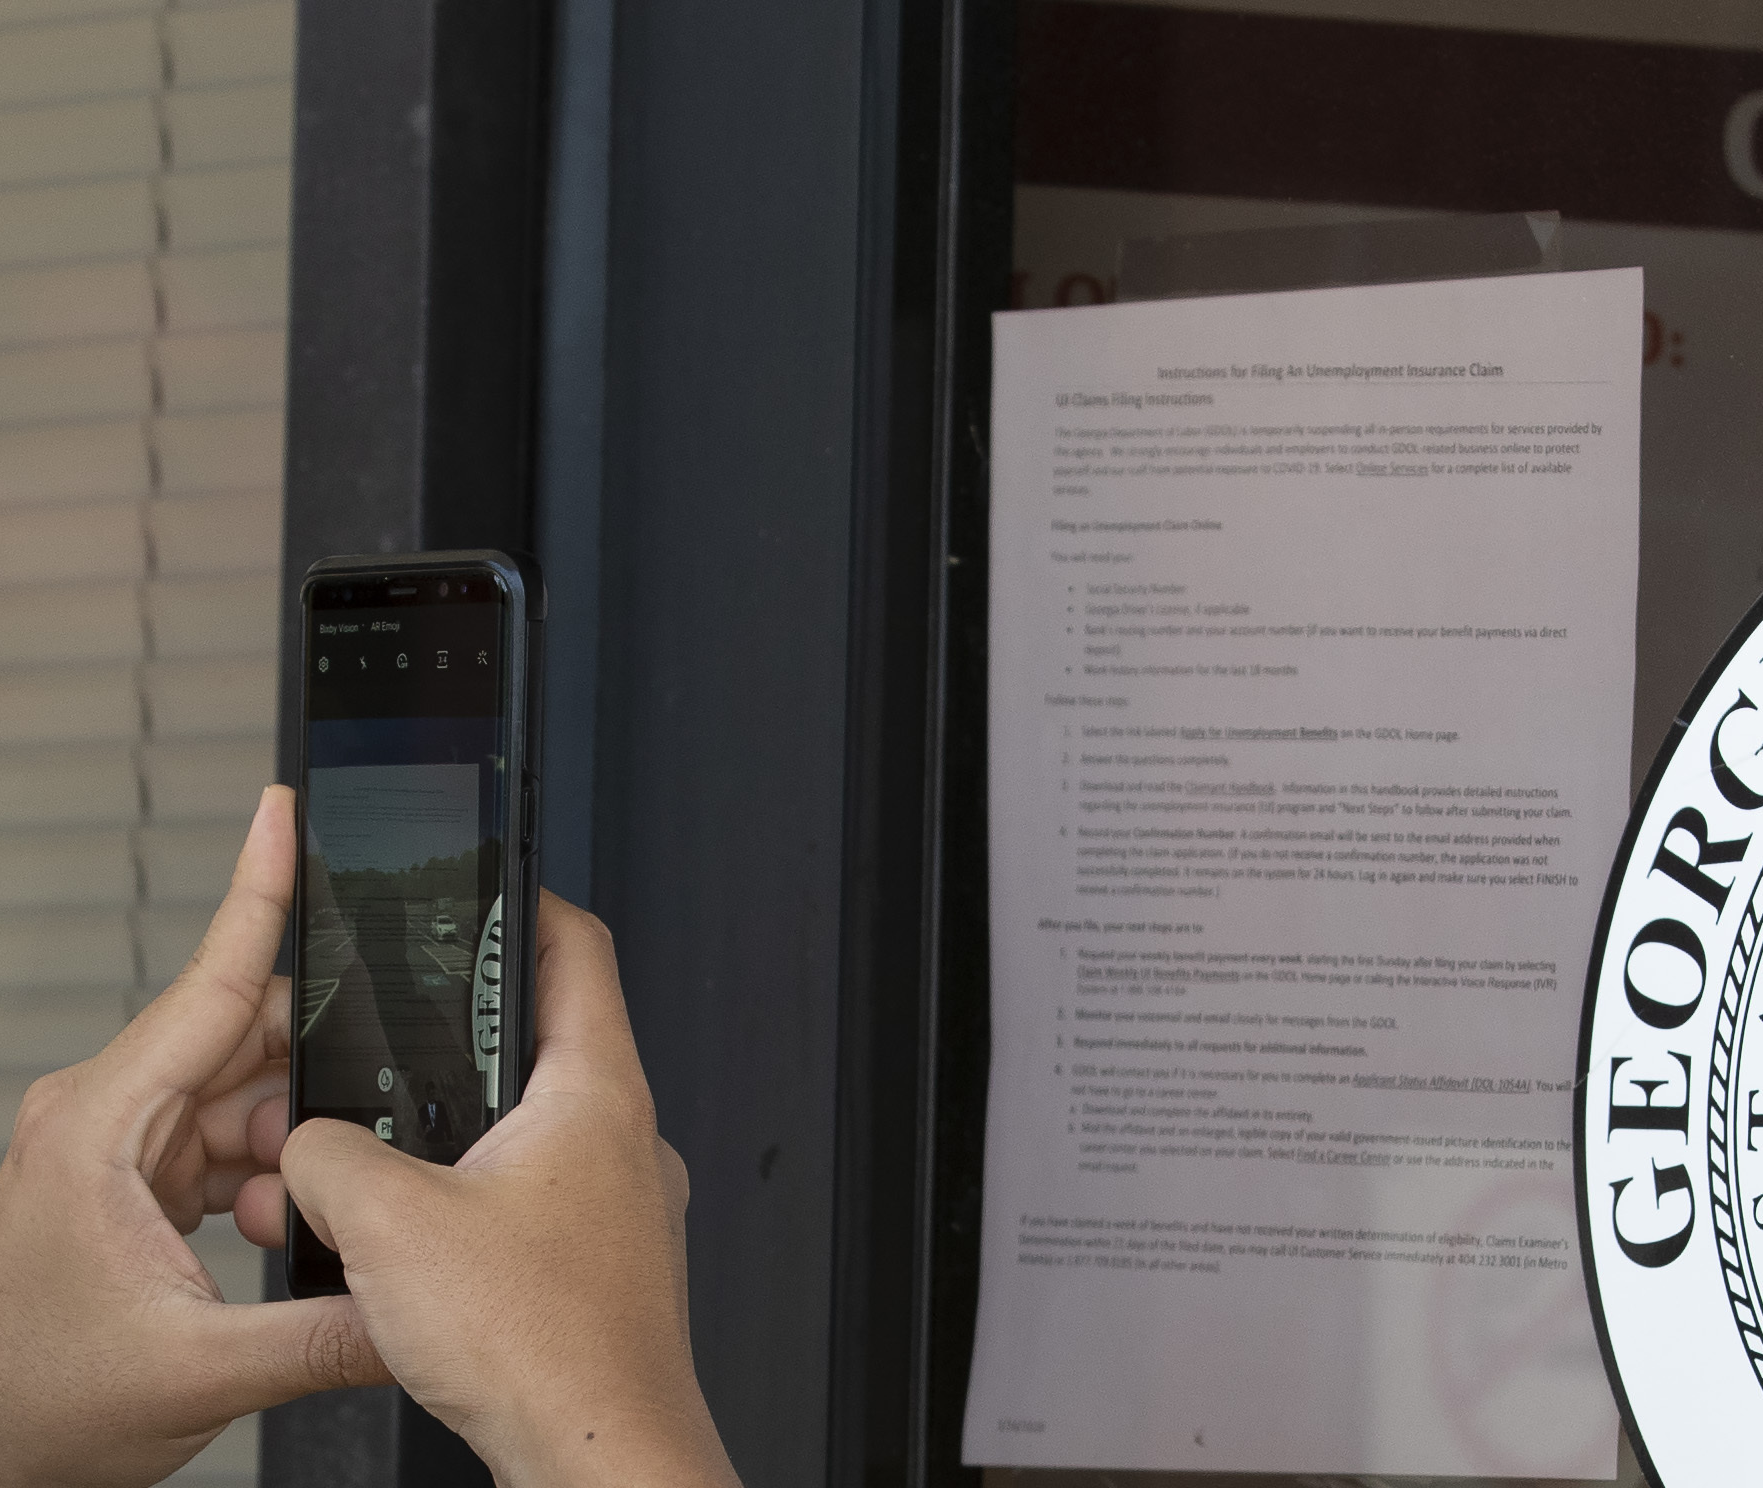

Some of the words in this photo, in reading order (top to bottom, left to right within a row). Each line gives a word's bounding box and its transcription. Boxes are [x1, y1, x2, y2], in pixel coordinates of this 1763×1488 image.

[1157, 366, 1228, 380] Instructions
[1231, 365, 1247, 379] for
[1251, 364, 1283, 380] Filing
[1306, 362, 1404, 380] Unemployment
[1407, 363, 1465, 377] Insurance
[1469, 361, 1503, 377] Claim
[339, 623, 359, 633] Vision
[370, 620, 382, 632] AR
